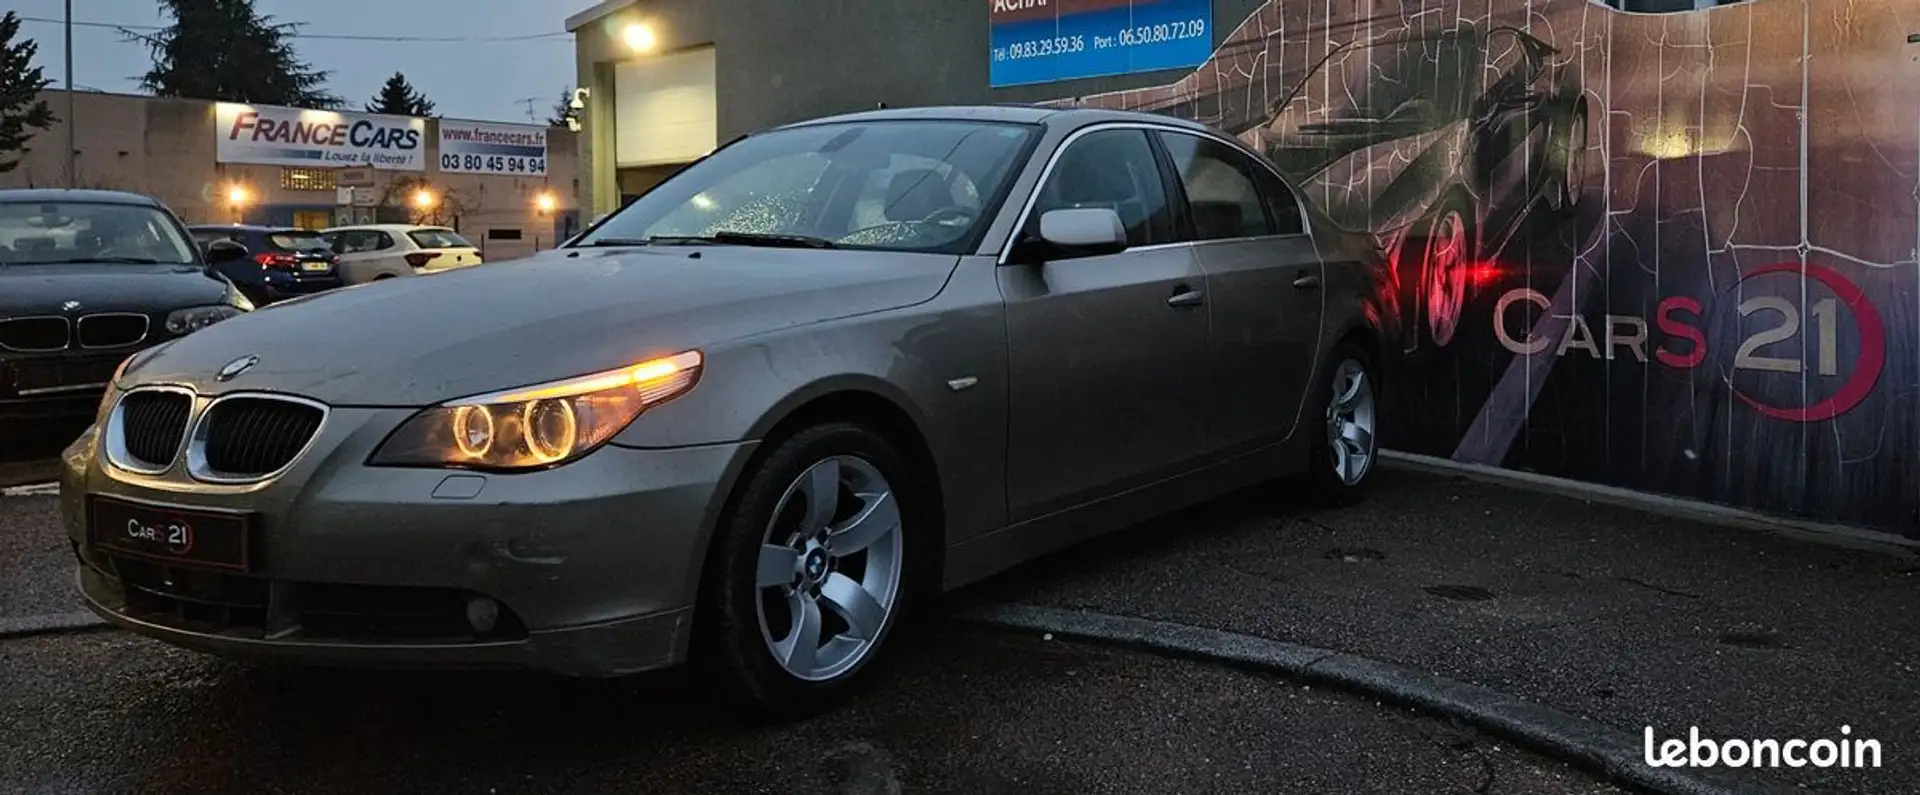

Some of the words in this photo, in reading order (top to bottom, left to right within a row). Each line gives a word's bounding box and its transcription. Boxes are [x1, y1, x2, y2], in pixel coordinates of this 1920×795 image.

[1010, 36, 1084, 59] 09.83.29.59.36
[1119, 19, 1205, 46] 06.50.80.72.09
[229, 111, 348, 147] FRANCE
[351, 120, 419, 149] CARS
[442, 128, 544, 145] www.francecars.fr
[442, 154, 459, 169] 03
[464, 154, 481, 170] 80
[487, 156, 503, 171] 45
[508, 157, 525, 172] 94
[529, 158, 545, 173] 94
[1734, 295, 1838, 376] 21
[168, 525, 186, 544] 21
